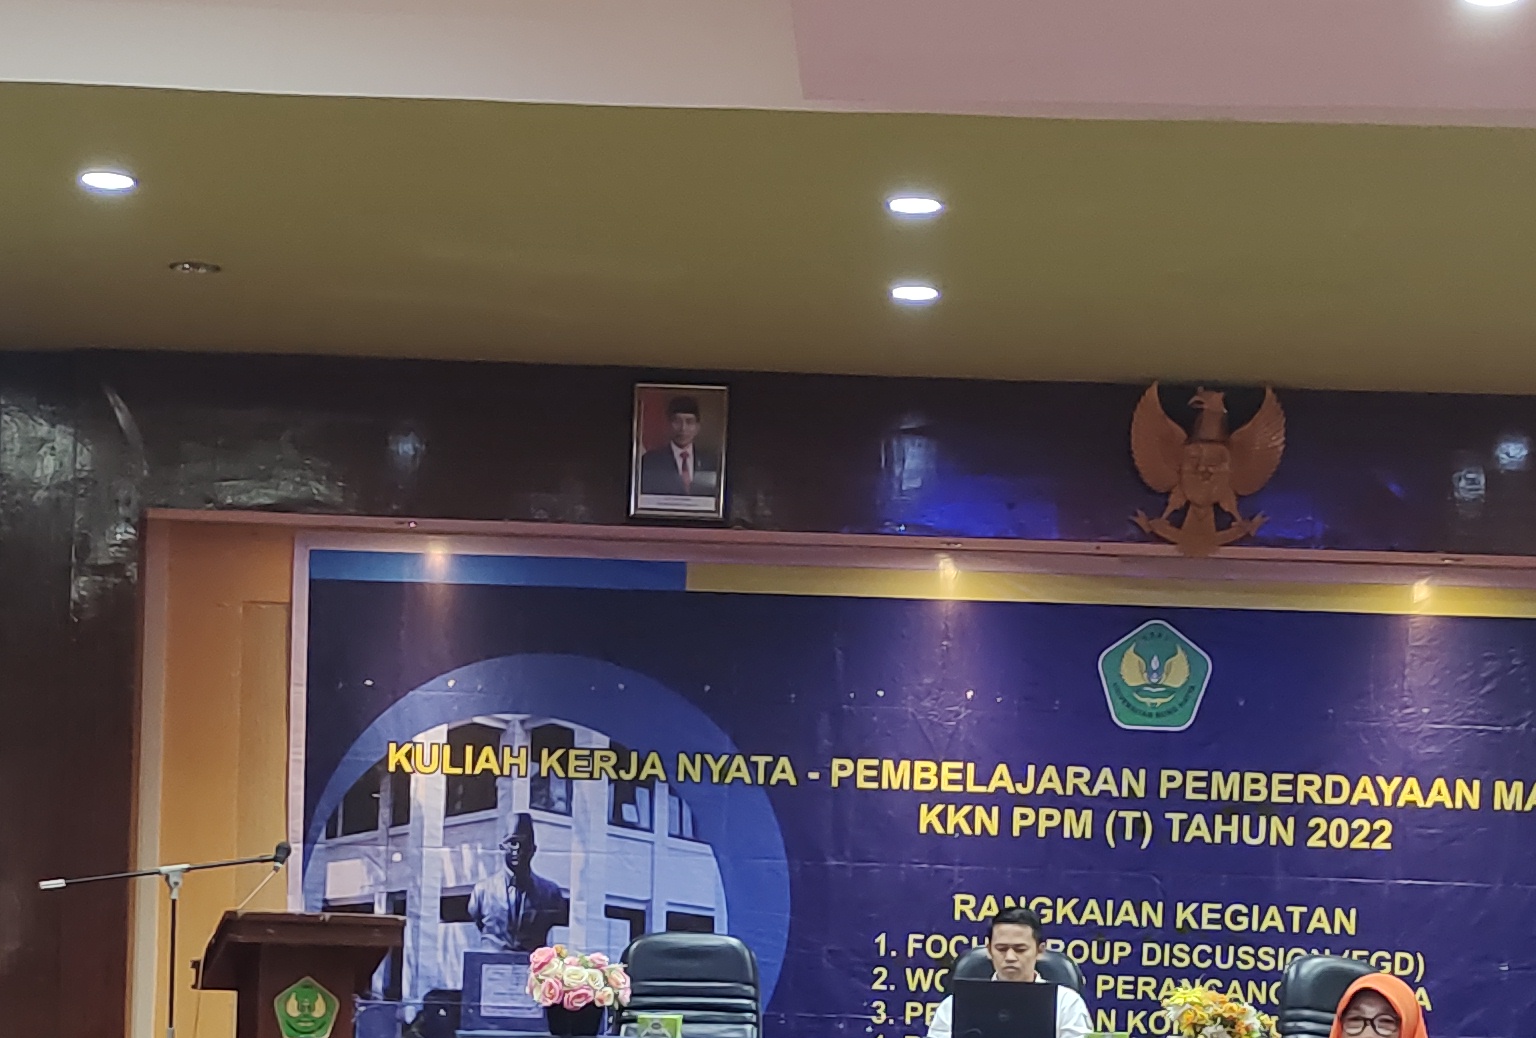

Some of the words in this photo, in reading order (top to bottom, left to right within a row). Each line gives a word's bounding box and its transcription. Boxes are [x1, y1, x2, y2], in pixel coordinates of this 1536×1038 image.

[386, 742, 529, 778] KULIAH
[539, 747, 665, 781] KERJA
[677, 751, 798, 787] NYATA
[831, 757, 1146, 798] PEMBELAJARAN
[1159, 770, 1481, 811] PEMBERDAYAAN
[918, 804, 1002, 837] KKN
[1011, 806, 1093, 840] PPM
[1105, 806, 1153, 849] (T)
[1169, 813, 1296, 847] TAHUN
[1306, 817, 1393, 851] 2022
[1175, 901, 1357, 936] KEGIATAN
[874, 932, 897, 957] 1.
[871, 966, 896, 991] 2.
[871, 1000, 895, 1025] 3.
